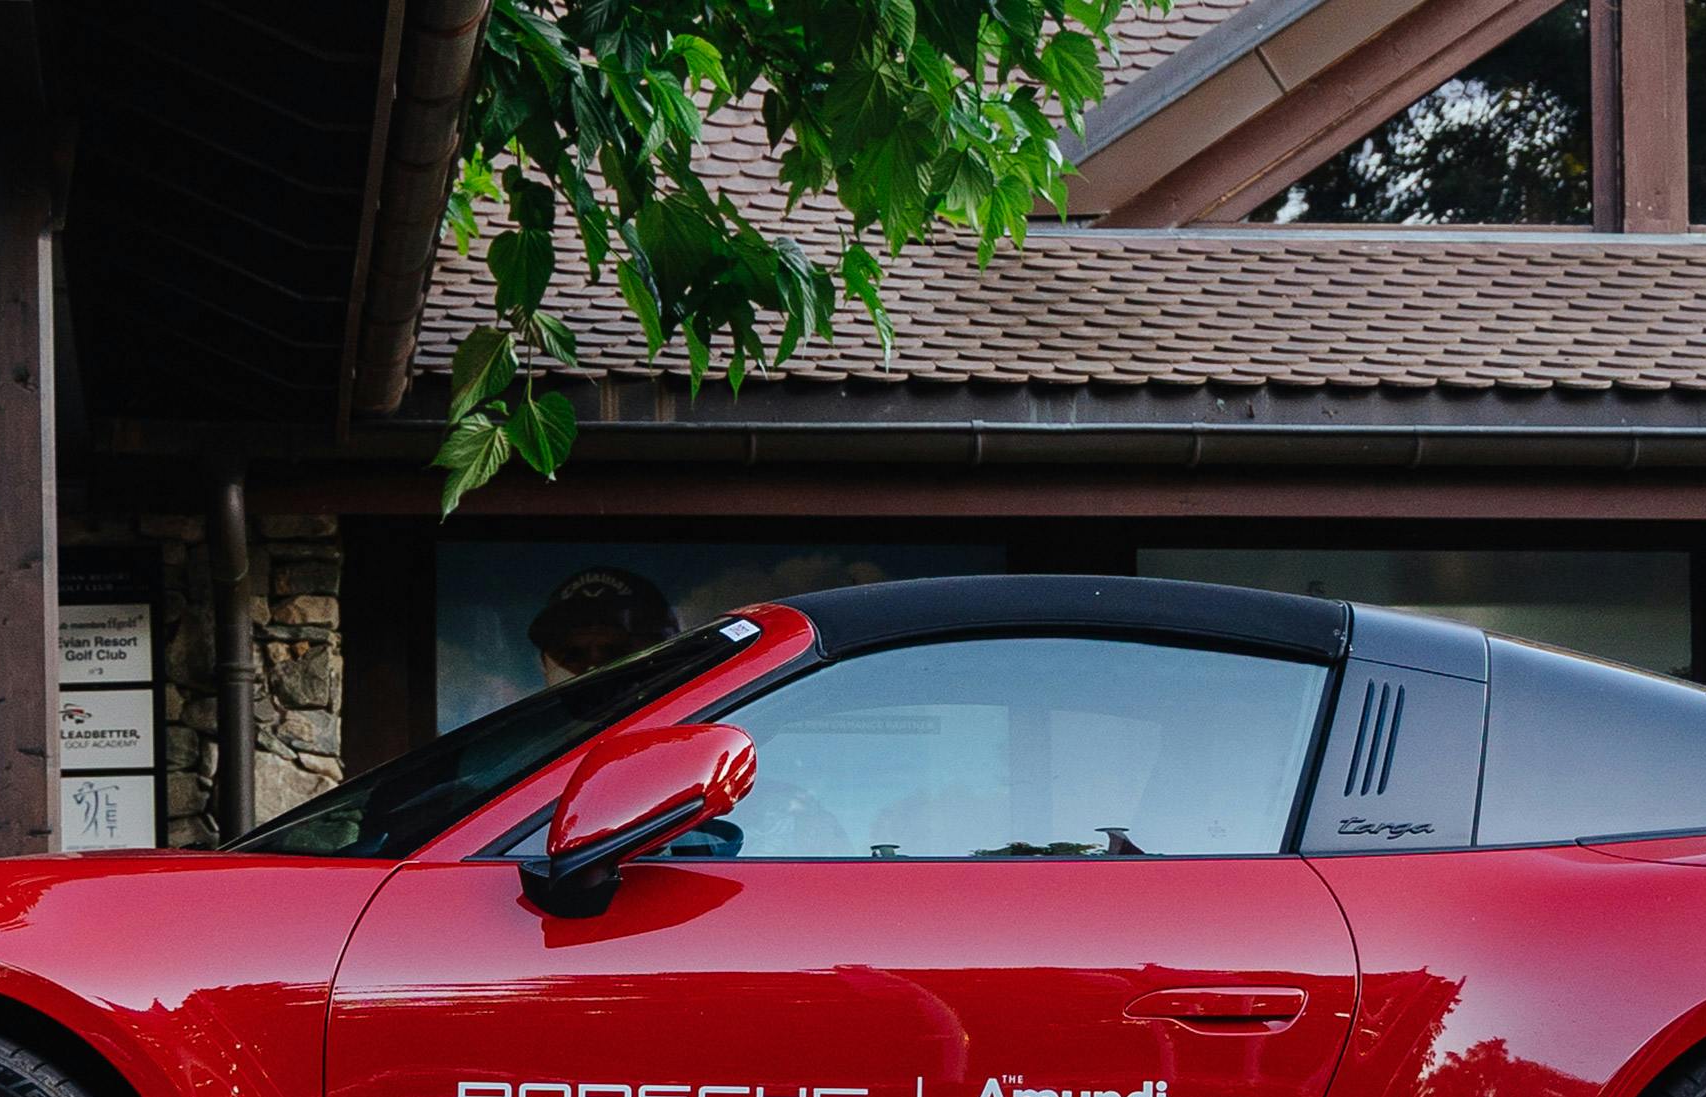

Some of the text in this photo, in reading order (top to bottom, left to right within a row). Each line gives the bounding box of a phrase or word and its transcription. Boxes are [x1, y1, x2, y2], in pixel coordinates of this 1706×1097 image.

[94, 636, 138, 648] Resort
[65, 649, 127, 662] Golf Club
[1001, 1074, 1024, 1085] THE
